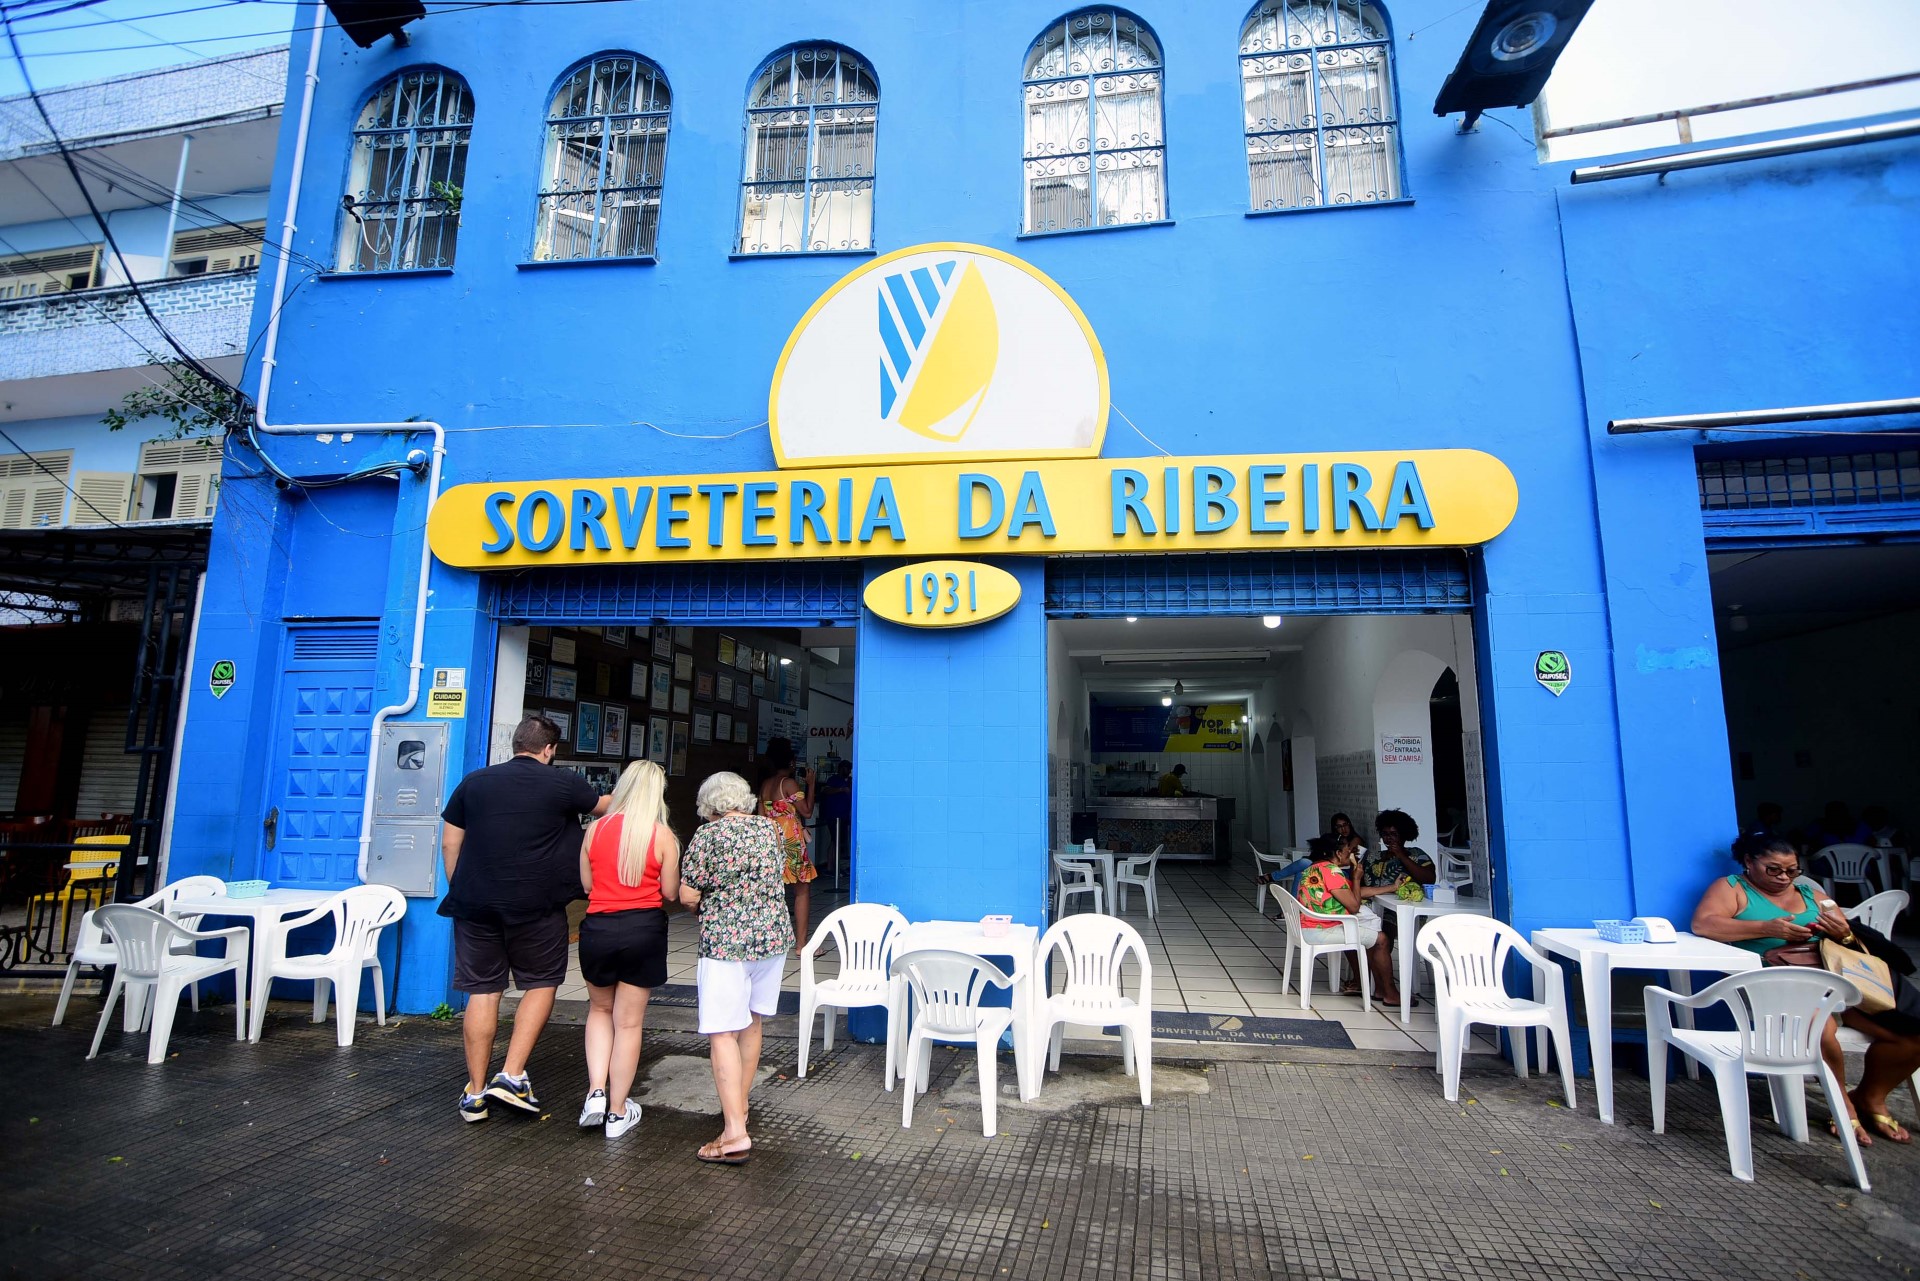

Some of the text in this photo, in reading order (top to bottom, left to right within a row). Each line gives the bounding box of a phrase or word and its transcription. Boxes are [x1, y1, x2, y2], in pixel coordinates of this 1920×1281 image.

[481, 460, 1436, 553] SORVETERIA DA RIBEIRA
[904, 570, 977, 614] 1931
[810, 727, 846, 737] CAIXA
